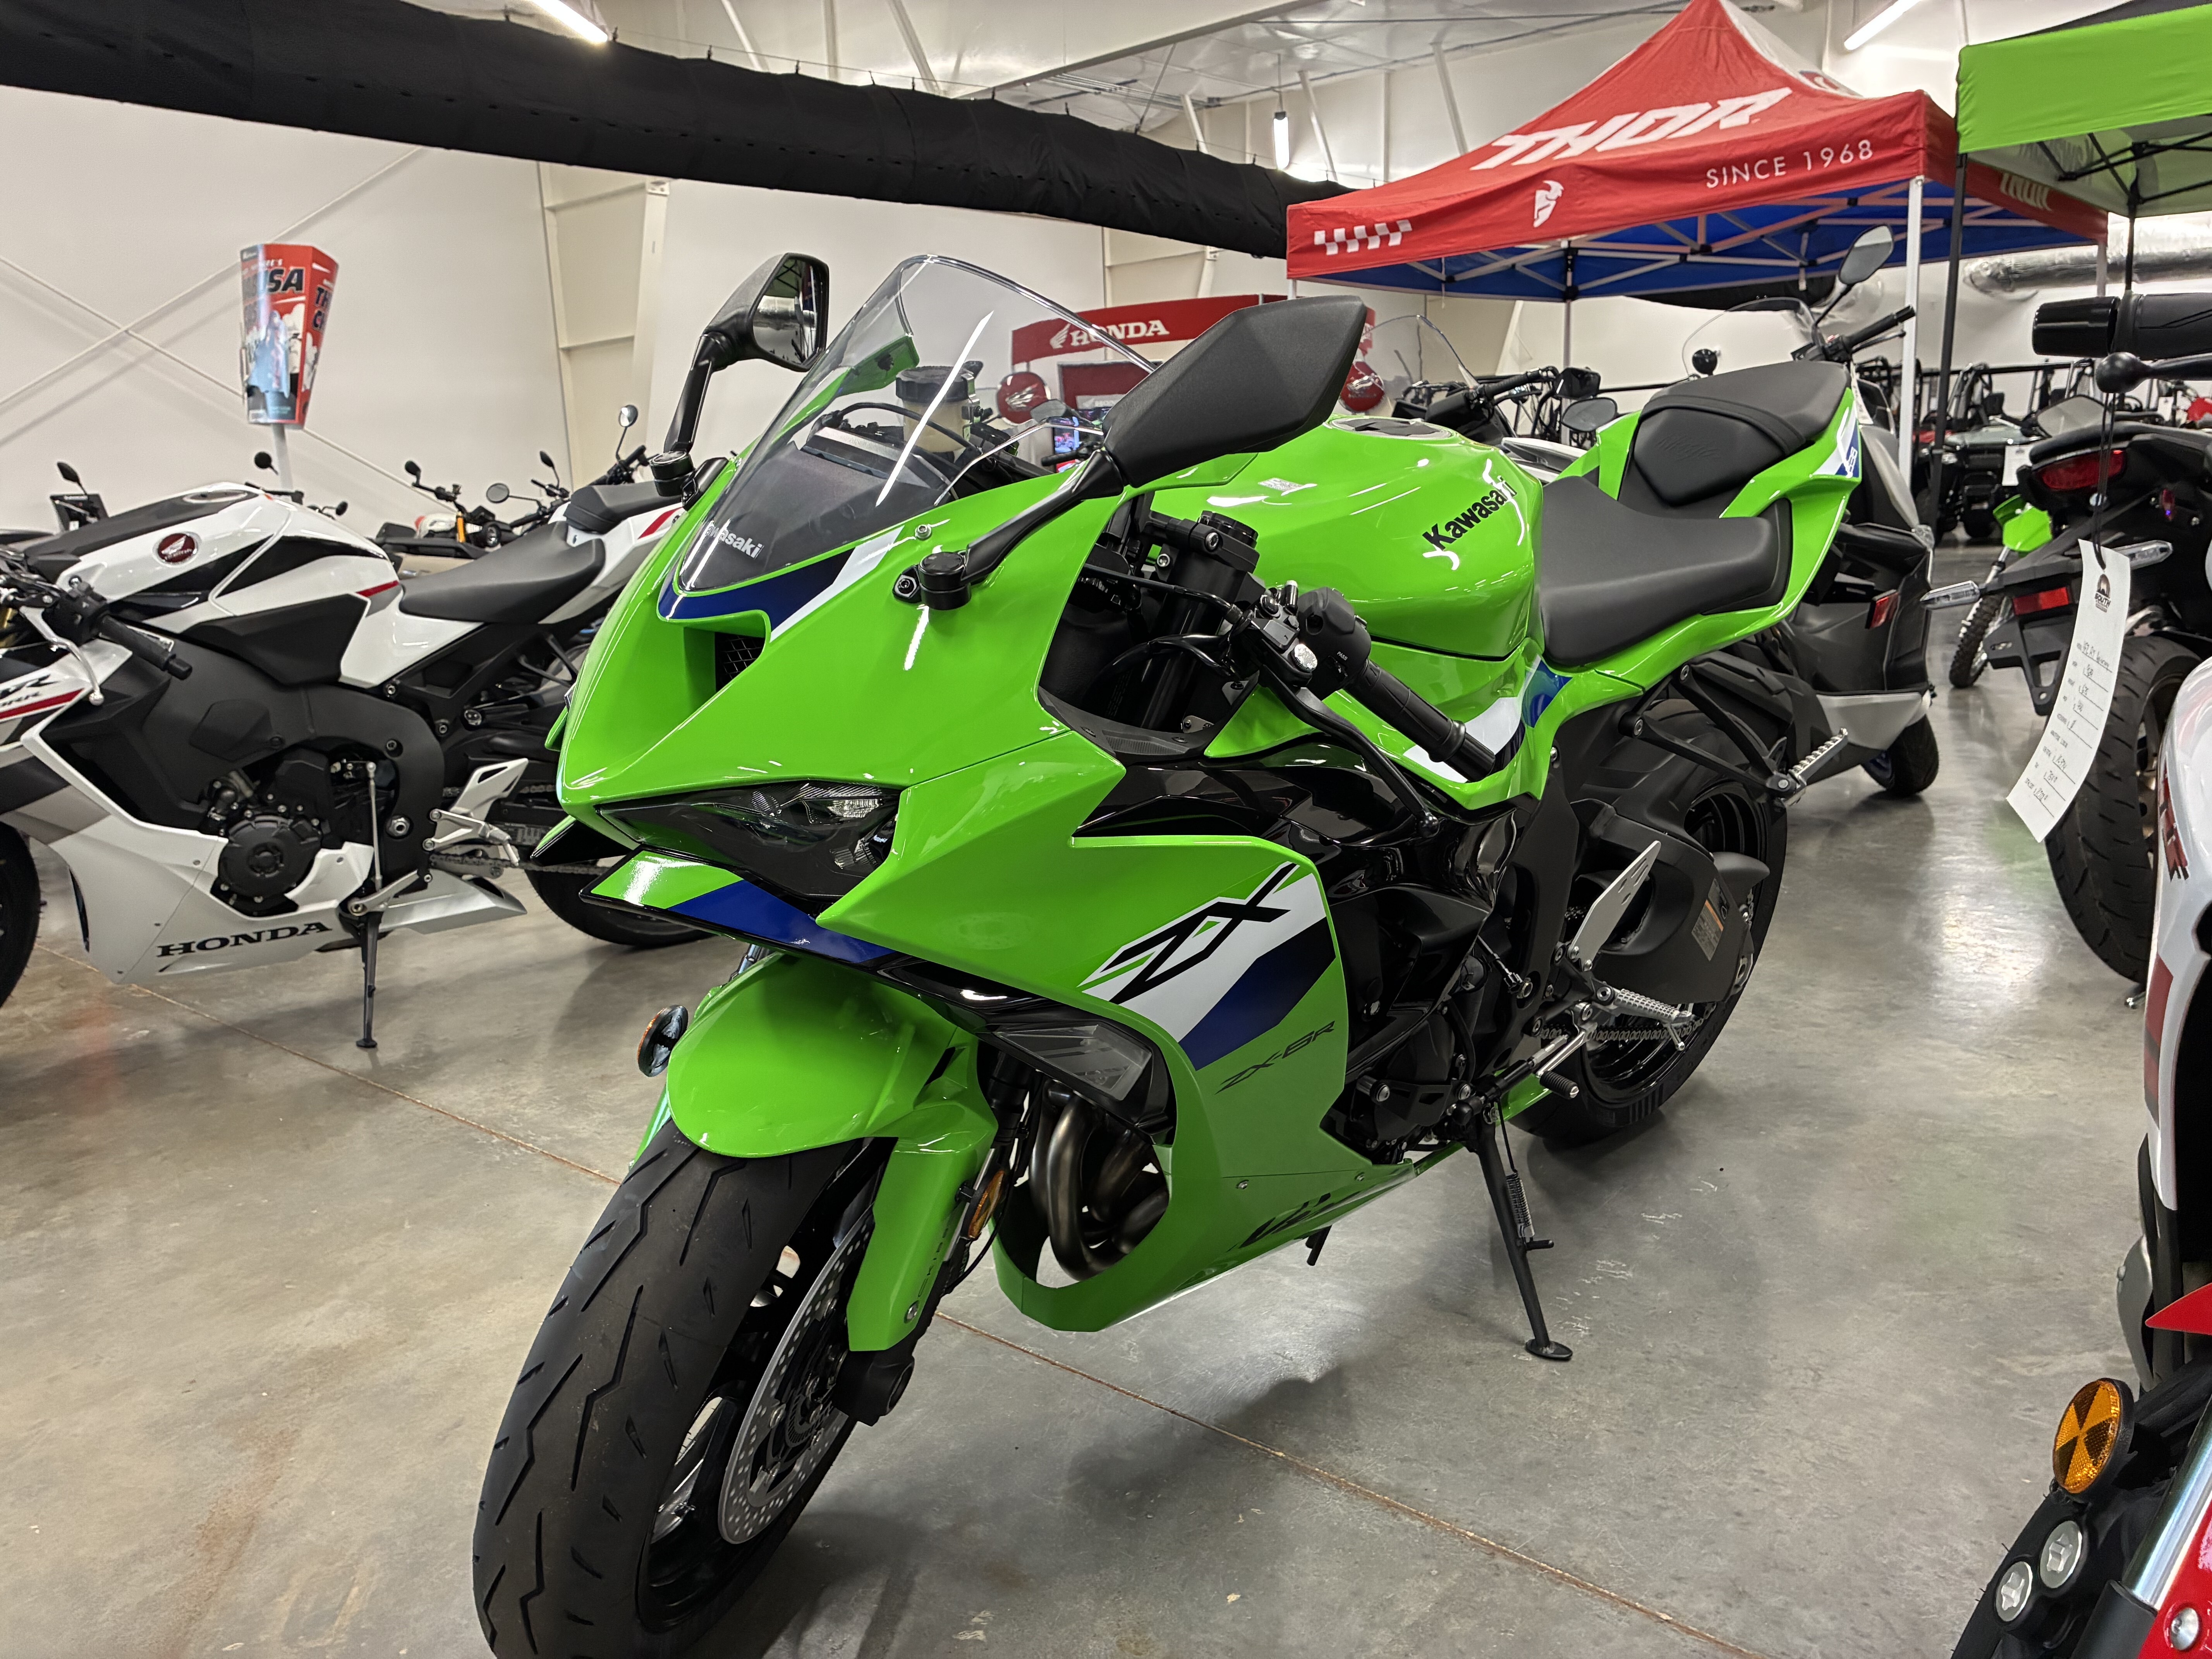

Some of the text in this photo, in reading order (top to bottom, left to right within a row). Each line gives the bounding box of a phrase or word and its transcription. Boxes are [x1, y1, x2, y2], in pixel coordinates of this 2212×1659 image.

[1470, 87, 1792, 170] THOR
[1706, 140, 1873, 188] SINCE 1968
[2095, 592, 2111, 607] SOUTH
[157, 922, 332, 957] HONDA
[1101, 862, 1297, 1005] ZX
[1214, 1020, 1335, 1094] ZX-6R
